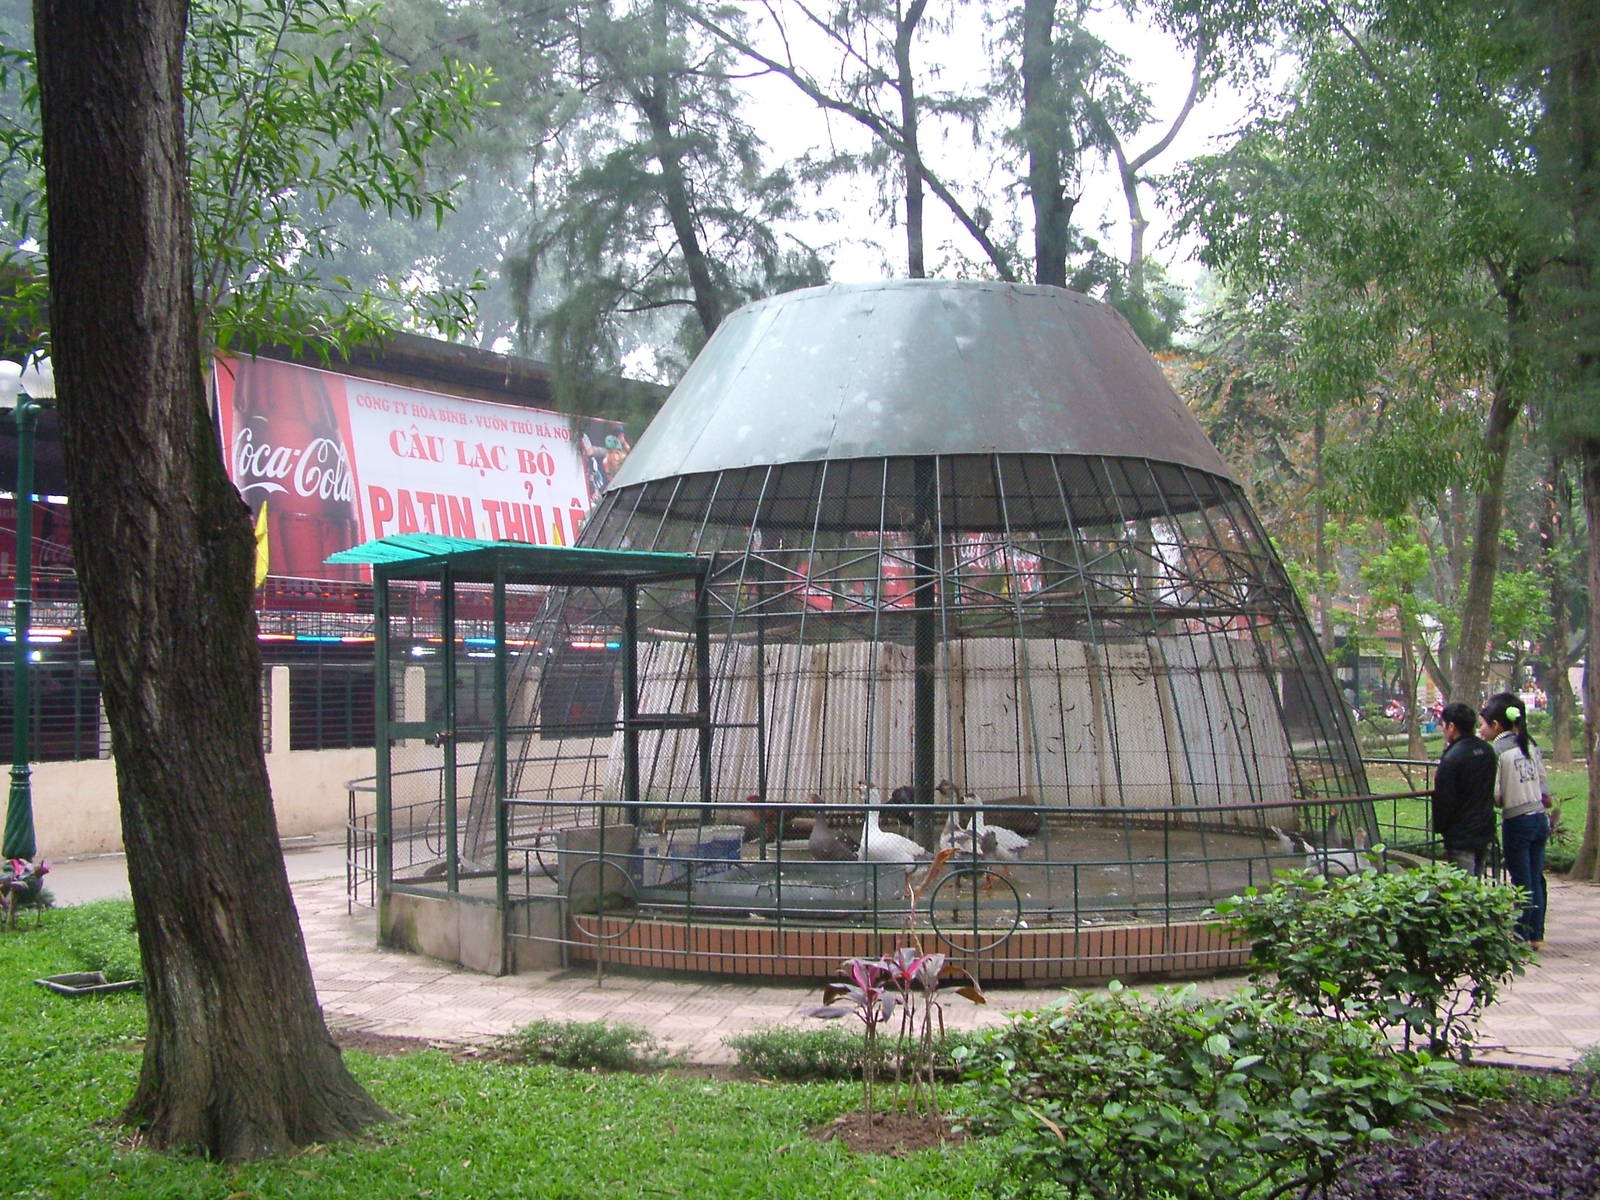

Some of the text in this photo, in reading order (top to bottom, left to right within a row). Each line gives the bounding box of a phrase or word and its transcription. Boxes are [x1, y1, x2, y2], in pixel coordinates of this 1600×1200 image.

[356, 392, 390, 412] CÔNG
[392, 400, 408, 415] TY
[233, 427, 354, 502] Coca-Cola
[389, 423, 556, 486] CÂU LẠC BỘ
[368, 485, 476, 541] PATIN
